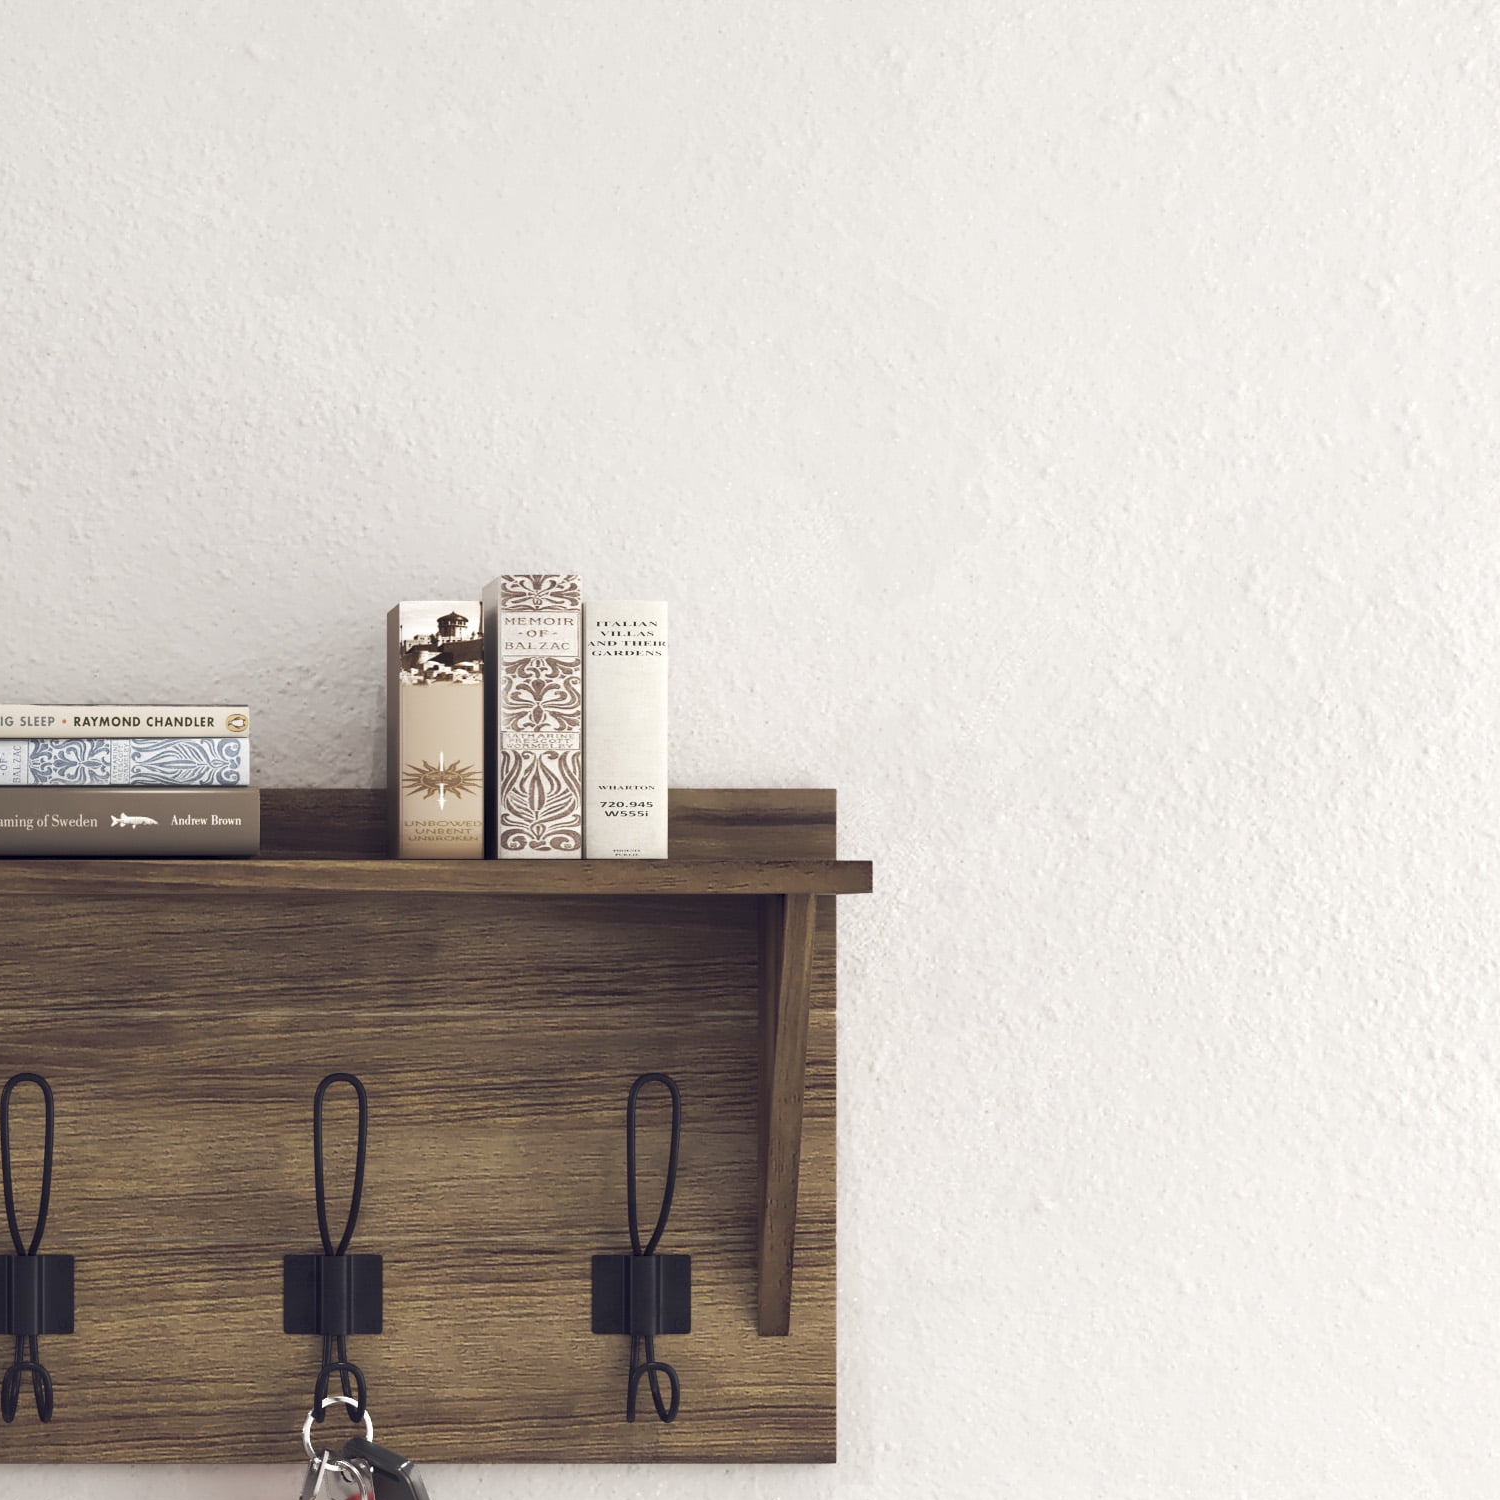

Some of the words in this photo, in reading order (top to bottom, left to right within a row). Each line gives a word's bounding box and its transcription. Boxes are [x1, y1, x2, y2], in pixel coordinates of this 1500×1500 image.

[504, 617, 574, 626] MEMOIR
[504, 641, 570, 650] BALZAC
[20, 716, 55, 727] SLEEP
[73, 716, 141, 727] RAYMOND
[146, 716, 215, 727] CHANDLER
[12, 745, 21, 783] BALZAC
[37, 814, 49, 828] of
[51, 814, 98, 828] Sweden
[171, 814, 208, 826] Andrew
[211, 814, 242, 826] Brown
